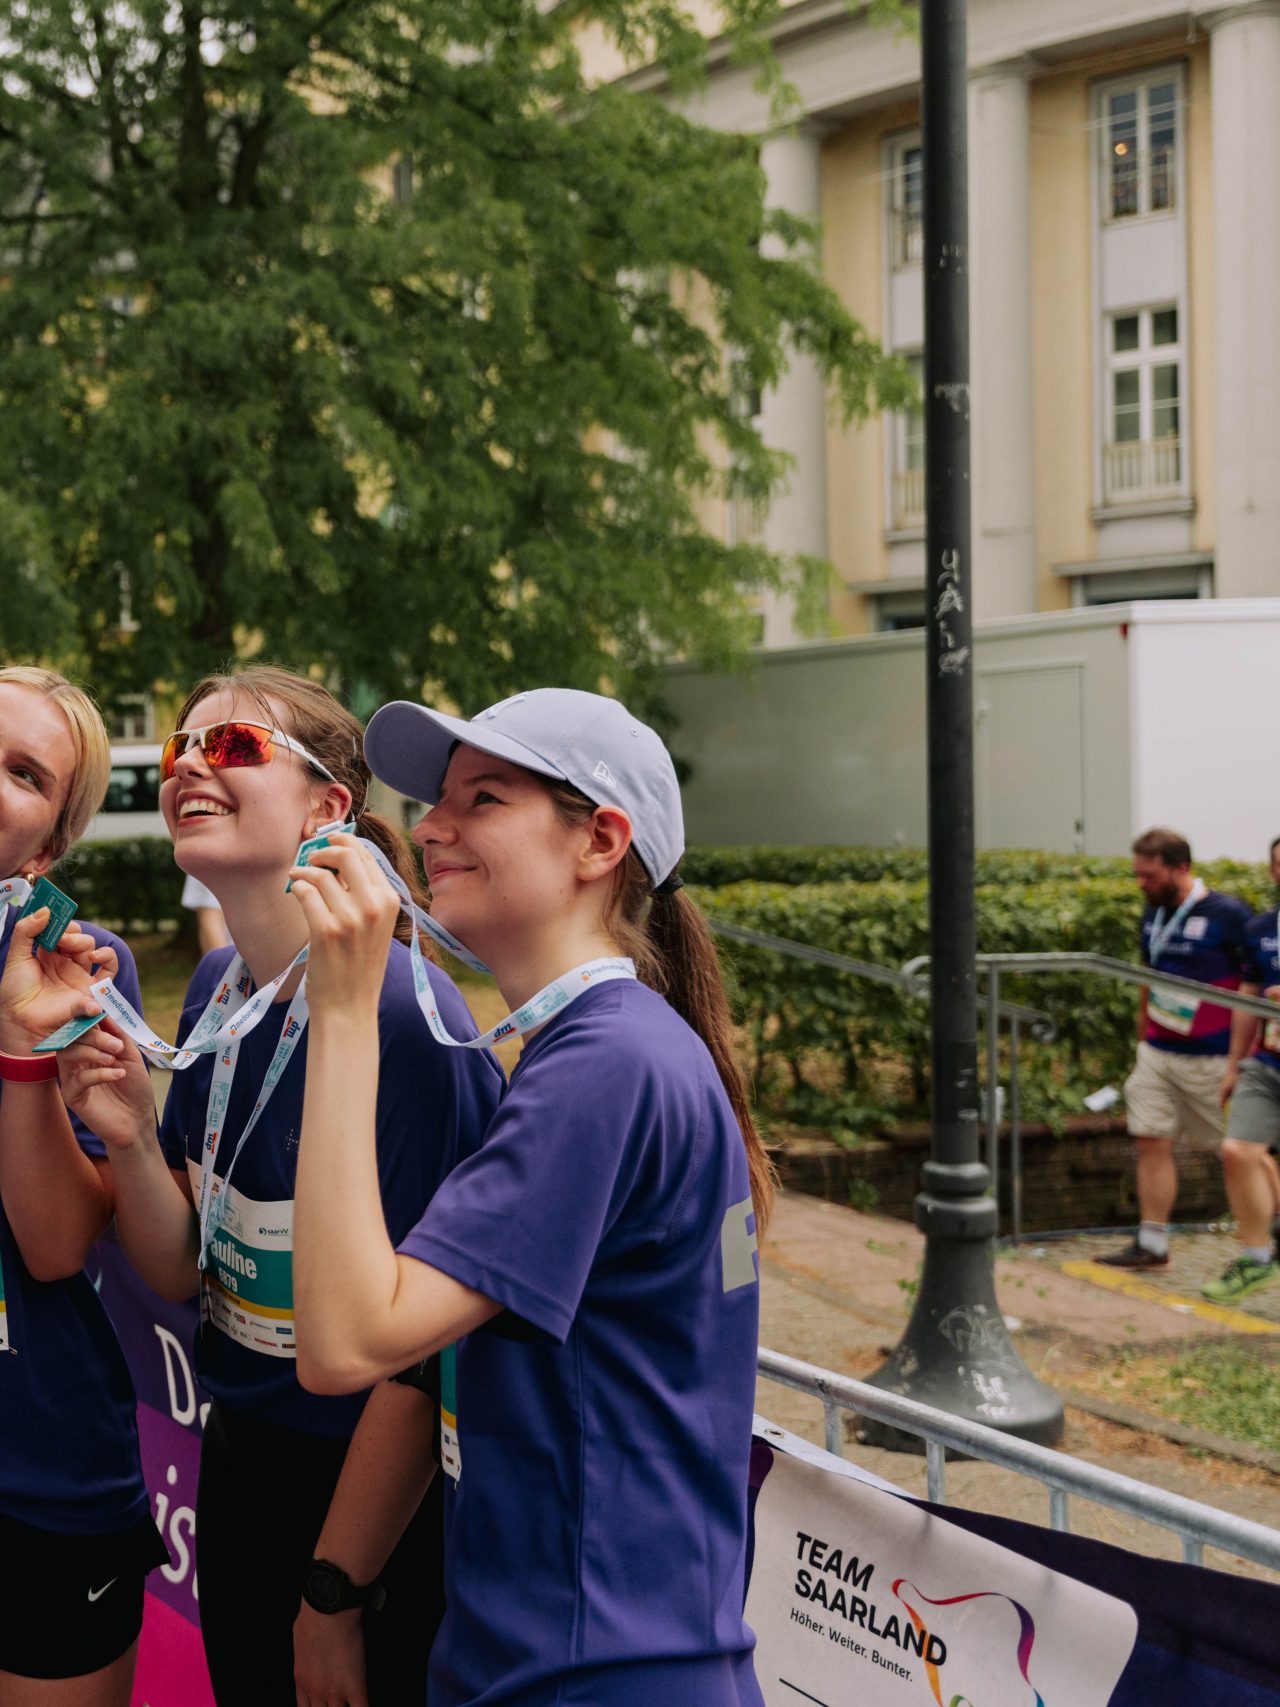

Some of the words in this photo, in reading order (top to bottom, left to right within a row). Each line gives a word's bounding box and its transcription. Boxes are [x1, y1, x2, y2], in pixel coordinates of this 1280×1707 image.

[287, 1021, 301, 1038] dm
[494, 1023, 513, 1039] dm
[153, 1040, 170, 1051] dm
[205, 1133, 214, 1150] dm
[211, 1237, 257, 1280] auline
[796, 1531, 875, 1592] TEAM
[795, 1569, 947, 1666] SAARLAND
[790, 1607, 825, 1637] Höher.
[829, 1626, 868, 1659] Weiter.
[871, 1650, 913, 1682] Bunter.
